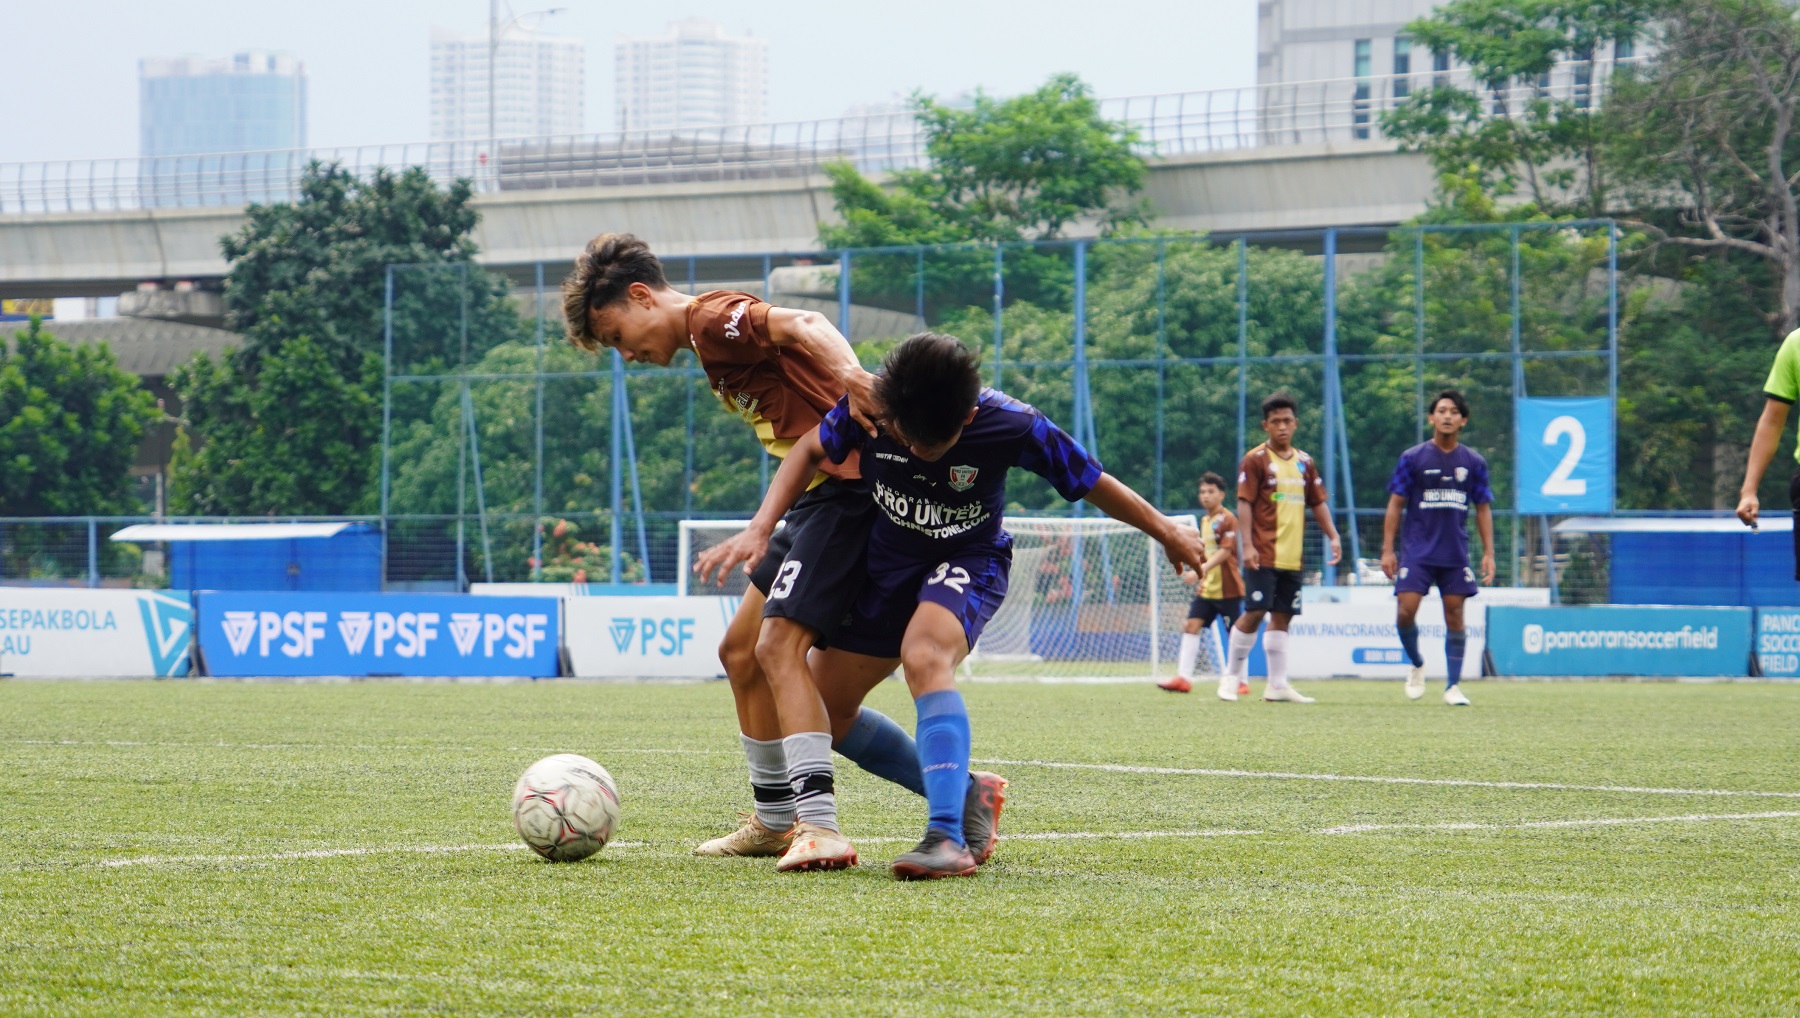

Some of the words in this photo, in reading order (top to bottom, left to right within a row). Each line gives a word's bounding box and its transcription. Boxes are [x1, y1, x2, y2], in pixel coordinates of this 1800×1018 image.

[1541, 415, 1586, 496] 2
[875, 481, 909, 518] PRO
[914, 504, 983, 526] UNTED
[927, 561, 971, 594] 32
[0, 609, 117, 631] SEPAKBOLA
[260, 611, 328, 657] PSF
[374, 611, 440, 657] PSF
[484, 613, 548, 659] PSF
[641, 617, 695, 656] PSF
[0, 635, 31, 655] AU
[1543, 624, 1718, 655] pancoransoccerfield
[1761, 633, 1800, 652] SOCC
[1761, 654, 1799, 673] FIELD
